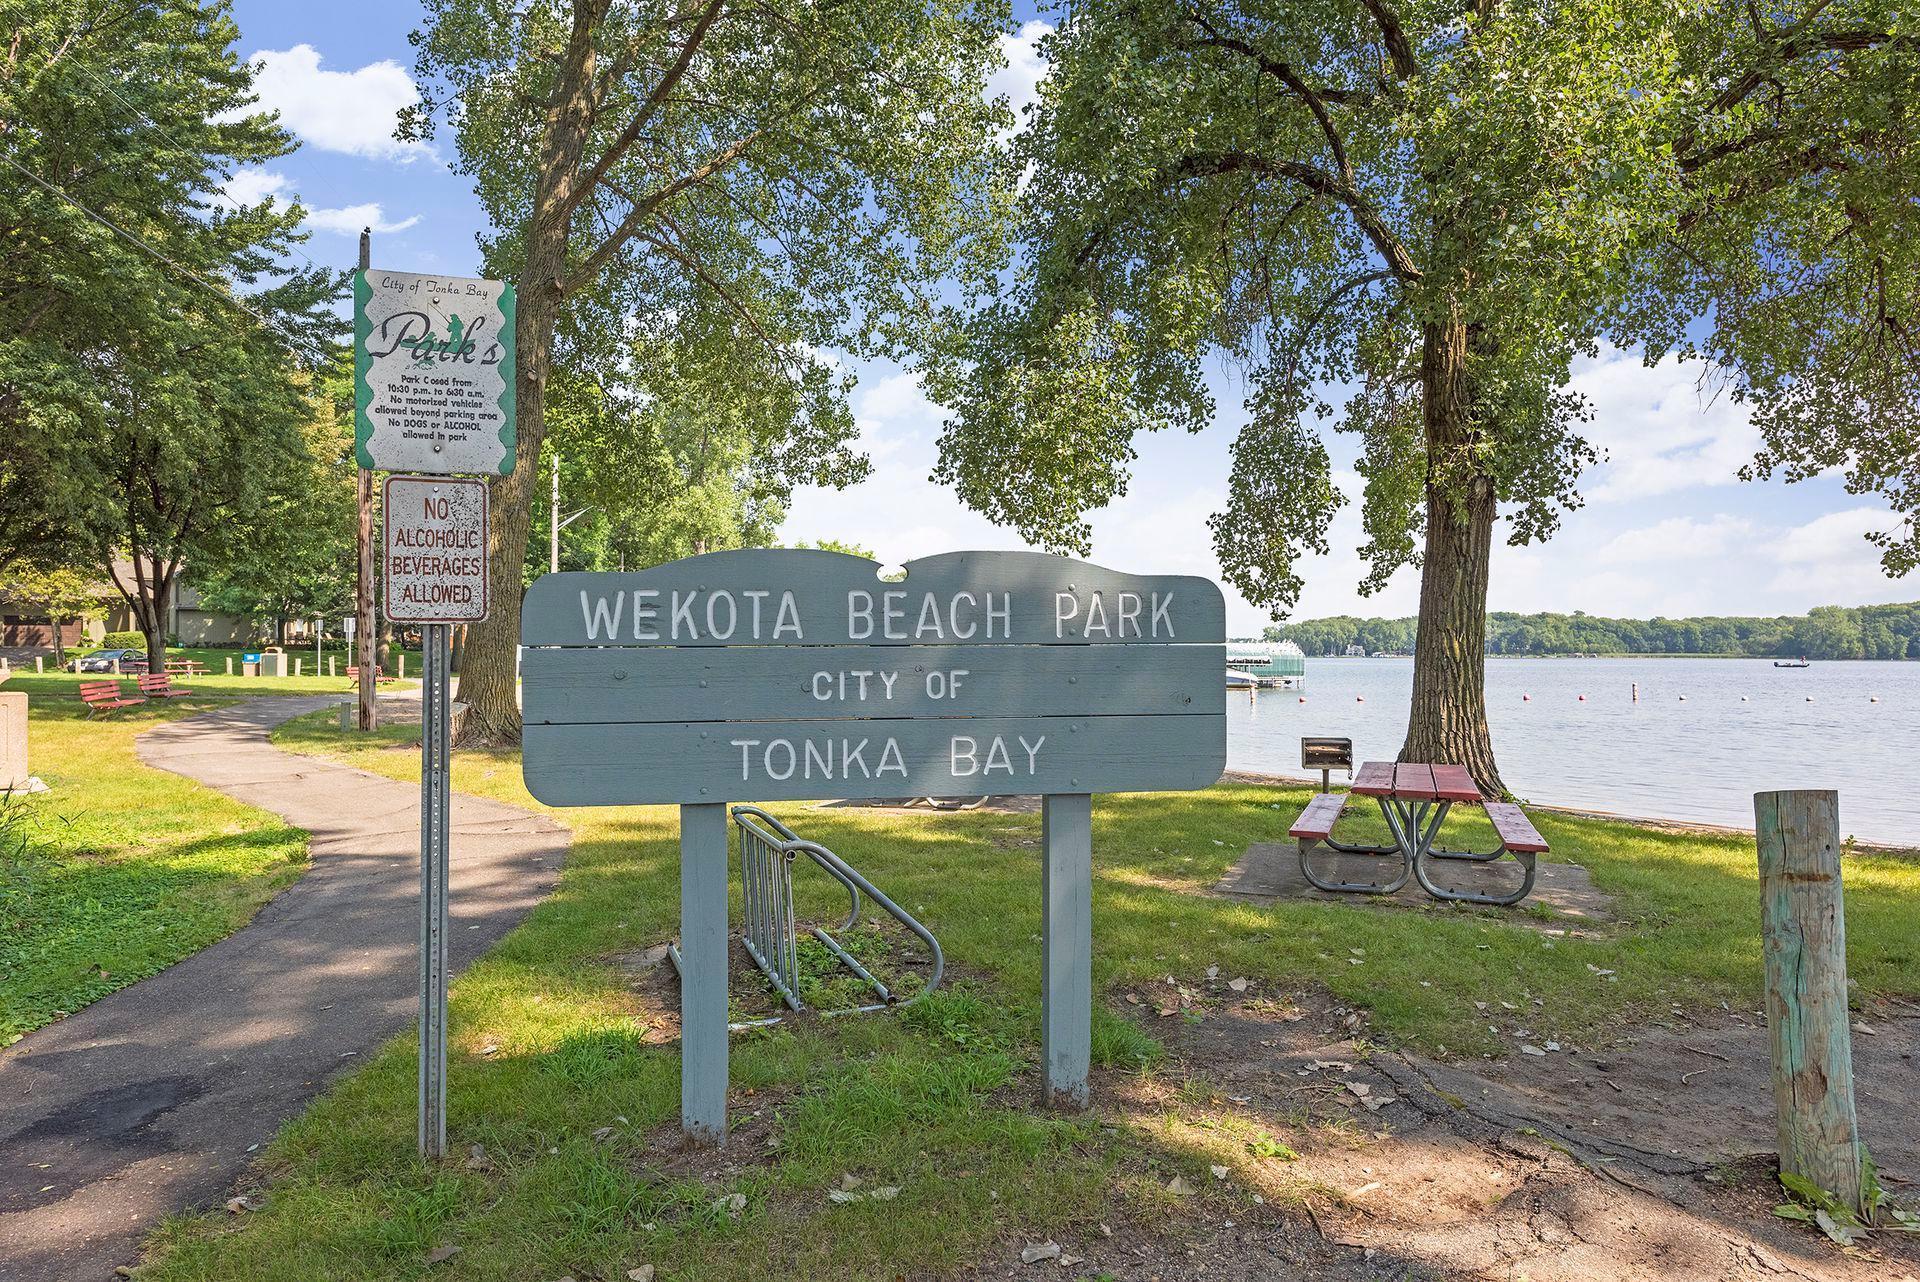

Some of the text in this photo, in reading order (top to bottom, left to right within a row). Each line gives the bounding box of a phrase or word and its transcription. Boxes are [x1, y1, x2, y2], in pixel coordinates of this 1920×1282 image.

[381, 276, 488, 299] City of Tonka Bay
[369, 311, 500, 365] Parks
[387, 383, 410, 393] 10:30
[413, 387, 431, 396] p.m.
[434, 388, 443, 396] to
[446, 388, 464, 397] 6:30
[401, 374, 472, 387] Park Cosed from
[390, 395, 483, 408] No motorized vehicles
[374, 405, 407, 415] allowed
[410, 407, 441, 419] beyond
[443, 410, 475, 420] parking
[388, 418, 481, 431] No DOGS or ALCOHOL
[402, 430, 467, 442] allowed in park
[424, 497, 449, 520] NO
[394, 528, 479, 549] ALCOHOLIC
[392, 556, 480, 577] BEVERAGES
[402, 584, 472, 604] ALLOWED
[579, 588, 1177, 642] WEKOTA BEACH PARK
[812, 669, 970, 701] CITY OF
[730, 734, 1047, 781] TONKA BAY
